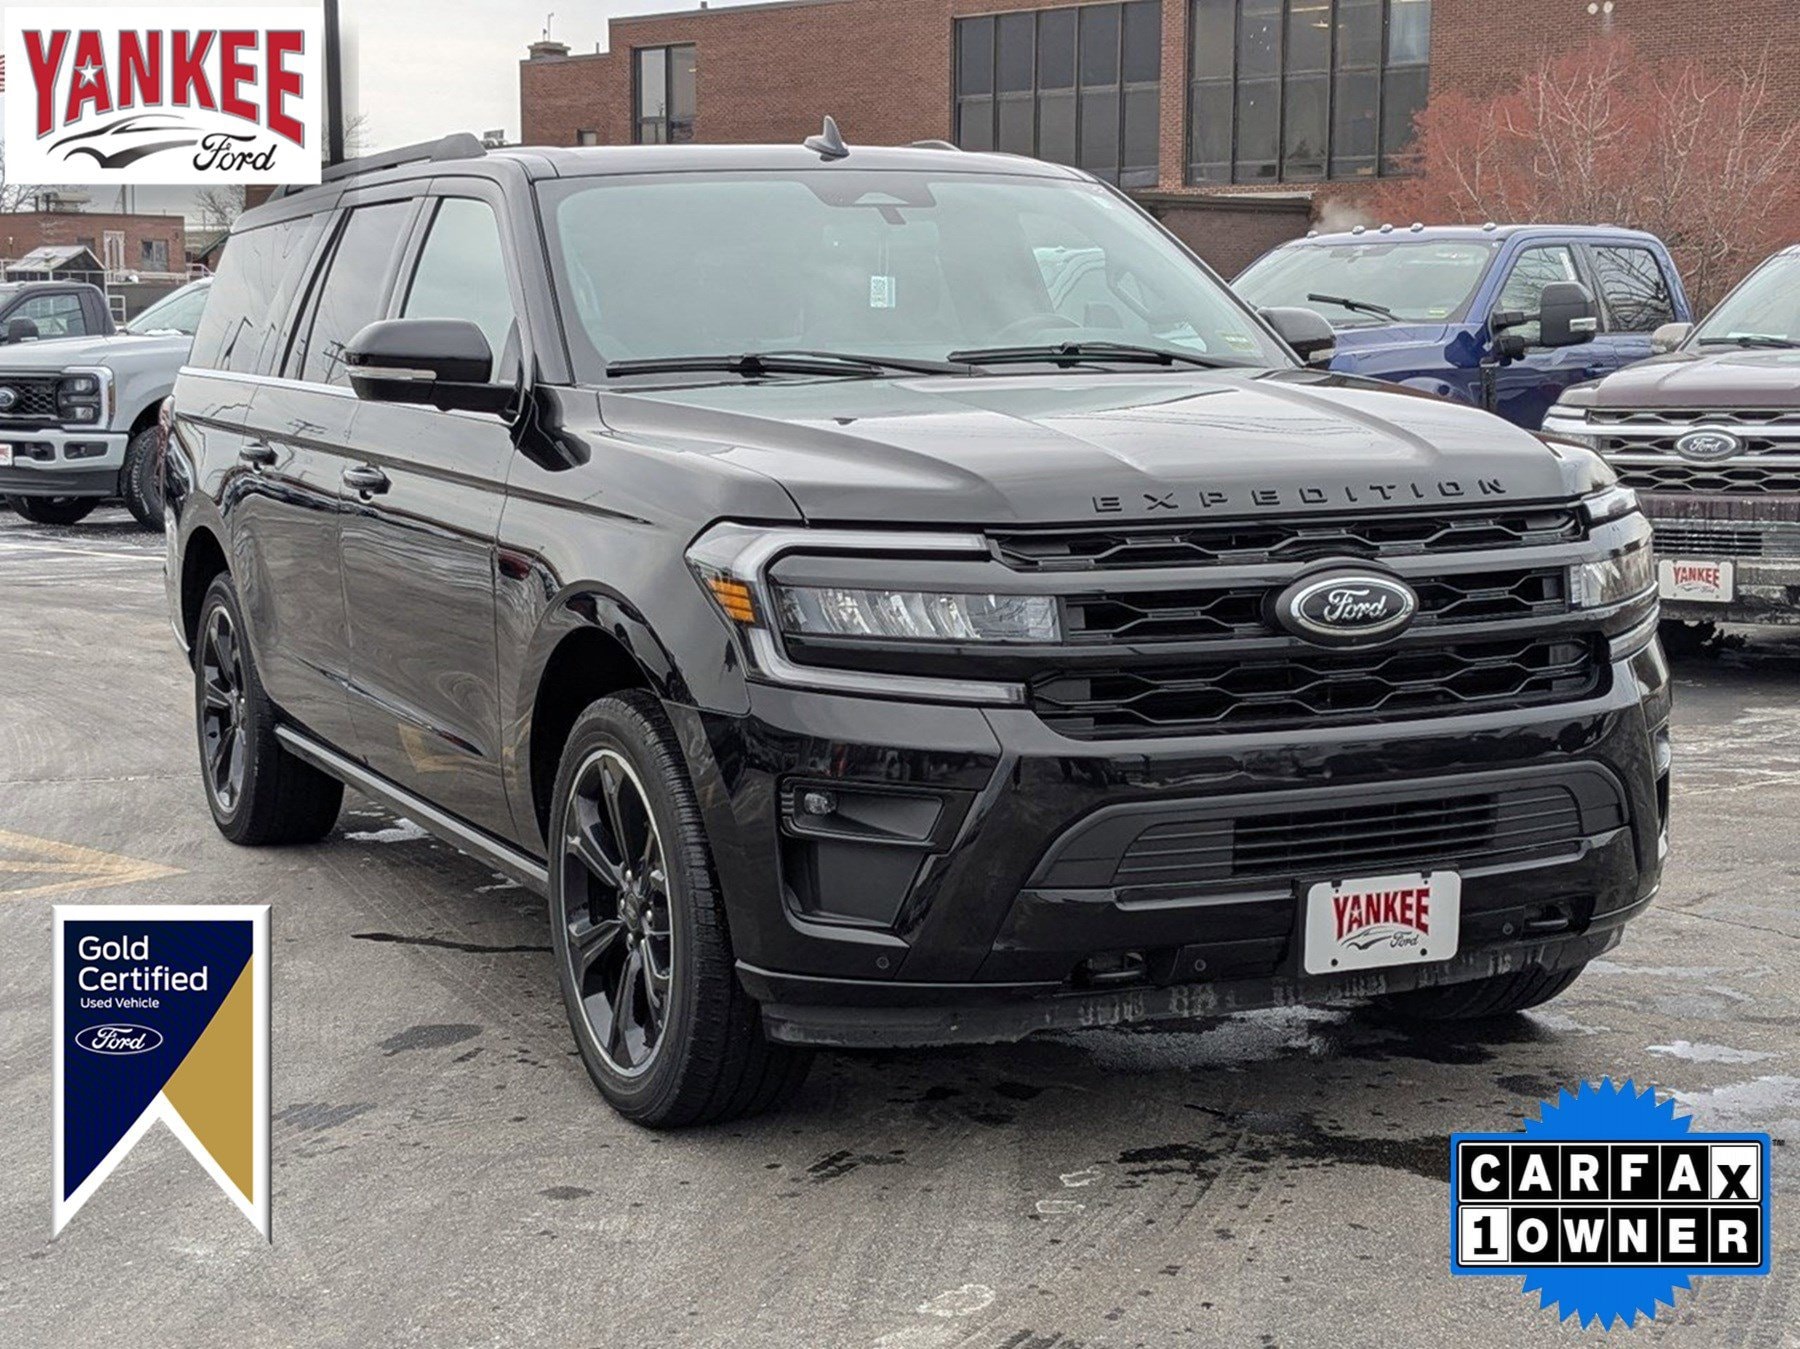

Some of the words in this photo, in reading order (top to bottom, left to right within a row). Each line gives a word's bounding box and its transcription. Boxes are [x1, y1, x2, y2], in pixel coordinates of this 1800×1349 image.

[1689, 437, 1721, 452] Ford
[1092, 478, 1507, 513] EXPEDITION
[1673, 567, 1720, 589] YANKEE
[1323, 589, 1388, 622] Ford
[1332, 888, 1431, 941] YANKEE
[1389, 931, 1420, 948] Ford
